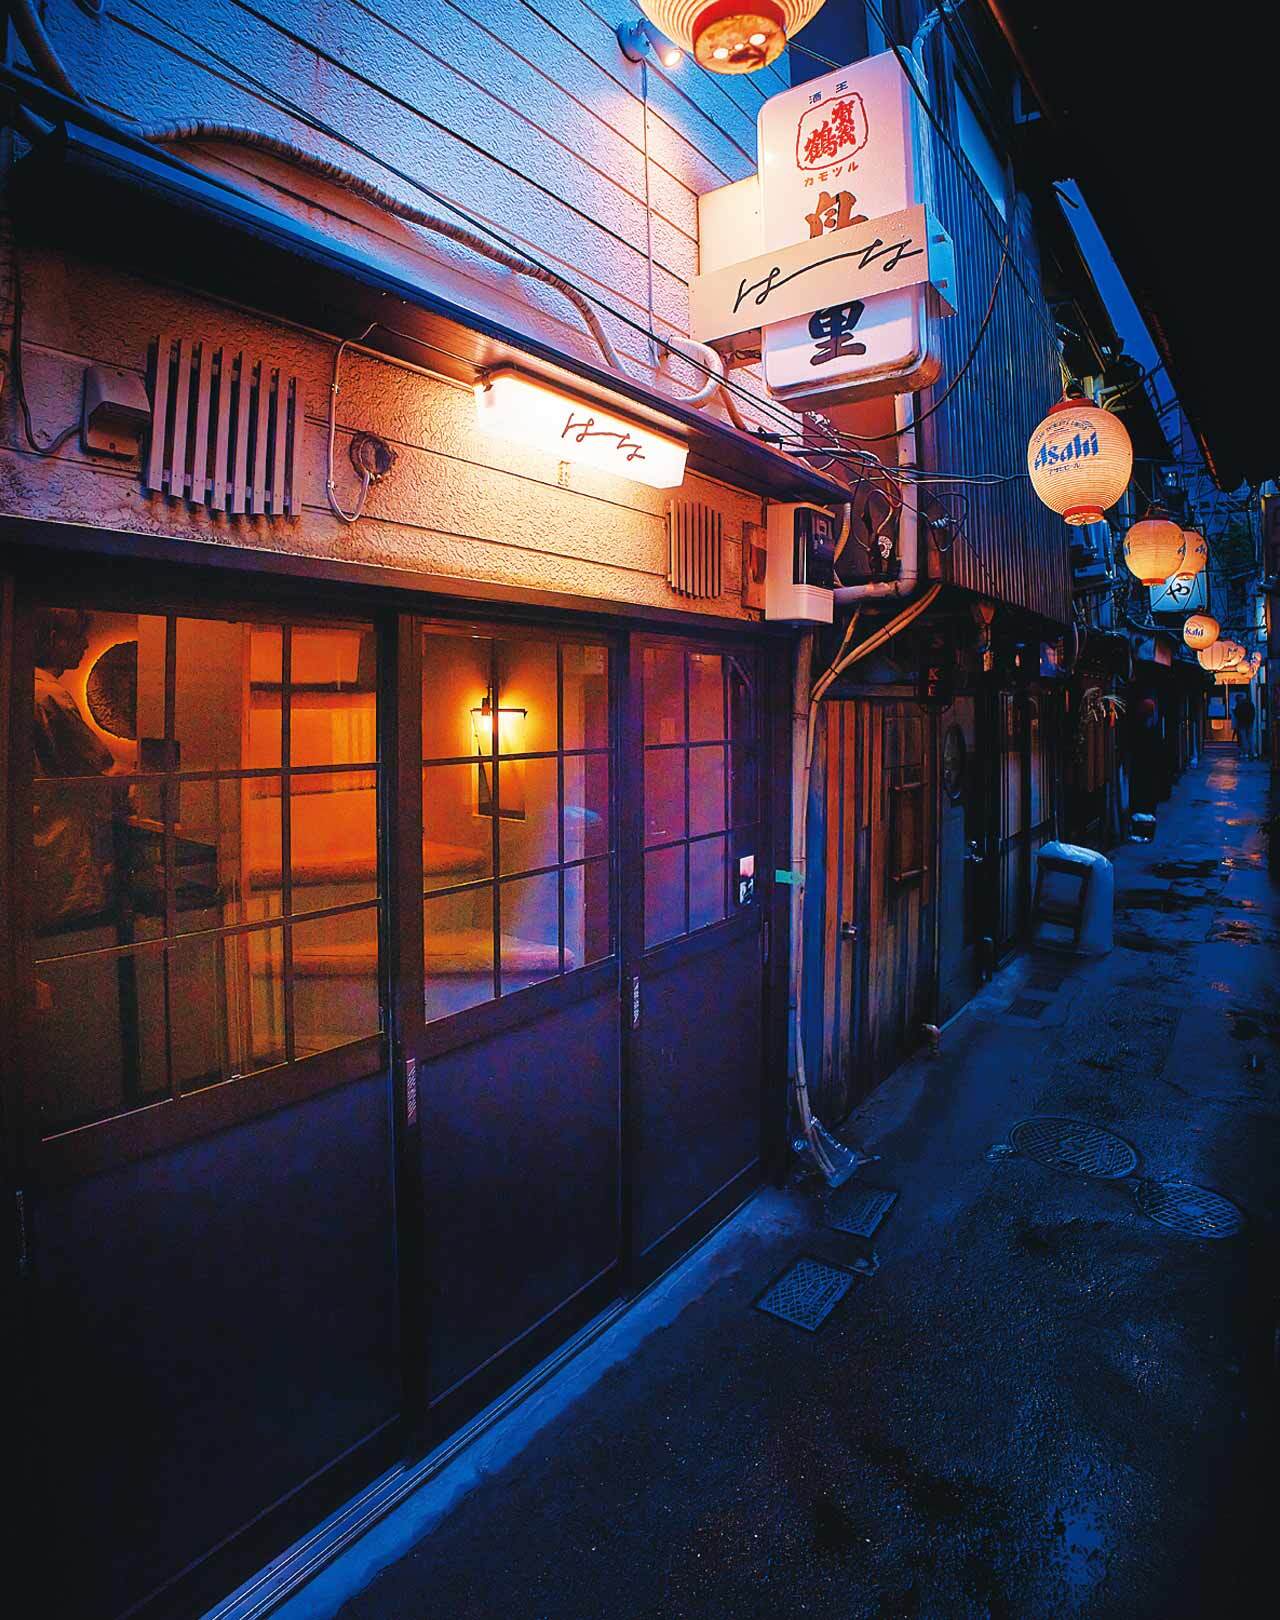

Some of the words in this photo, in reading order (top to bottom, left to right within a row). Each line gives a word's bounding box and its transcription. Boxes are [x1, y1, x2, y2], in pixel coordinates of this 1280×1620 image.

[808, 81, 849, 105] 酒王
[803, 161, 860, 187] カモツル
[1034, 431, 1099, 470] Asahi
